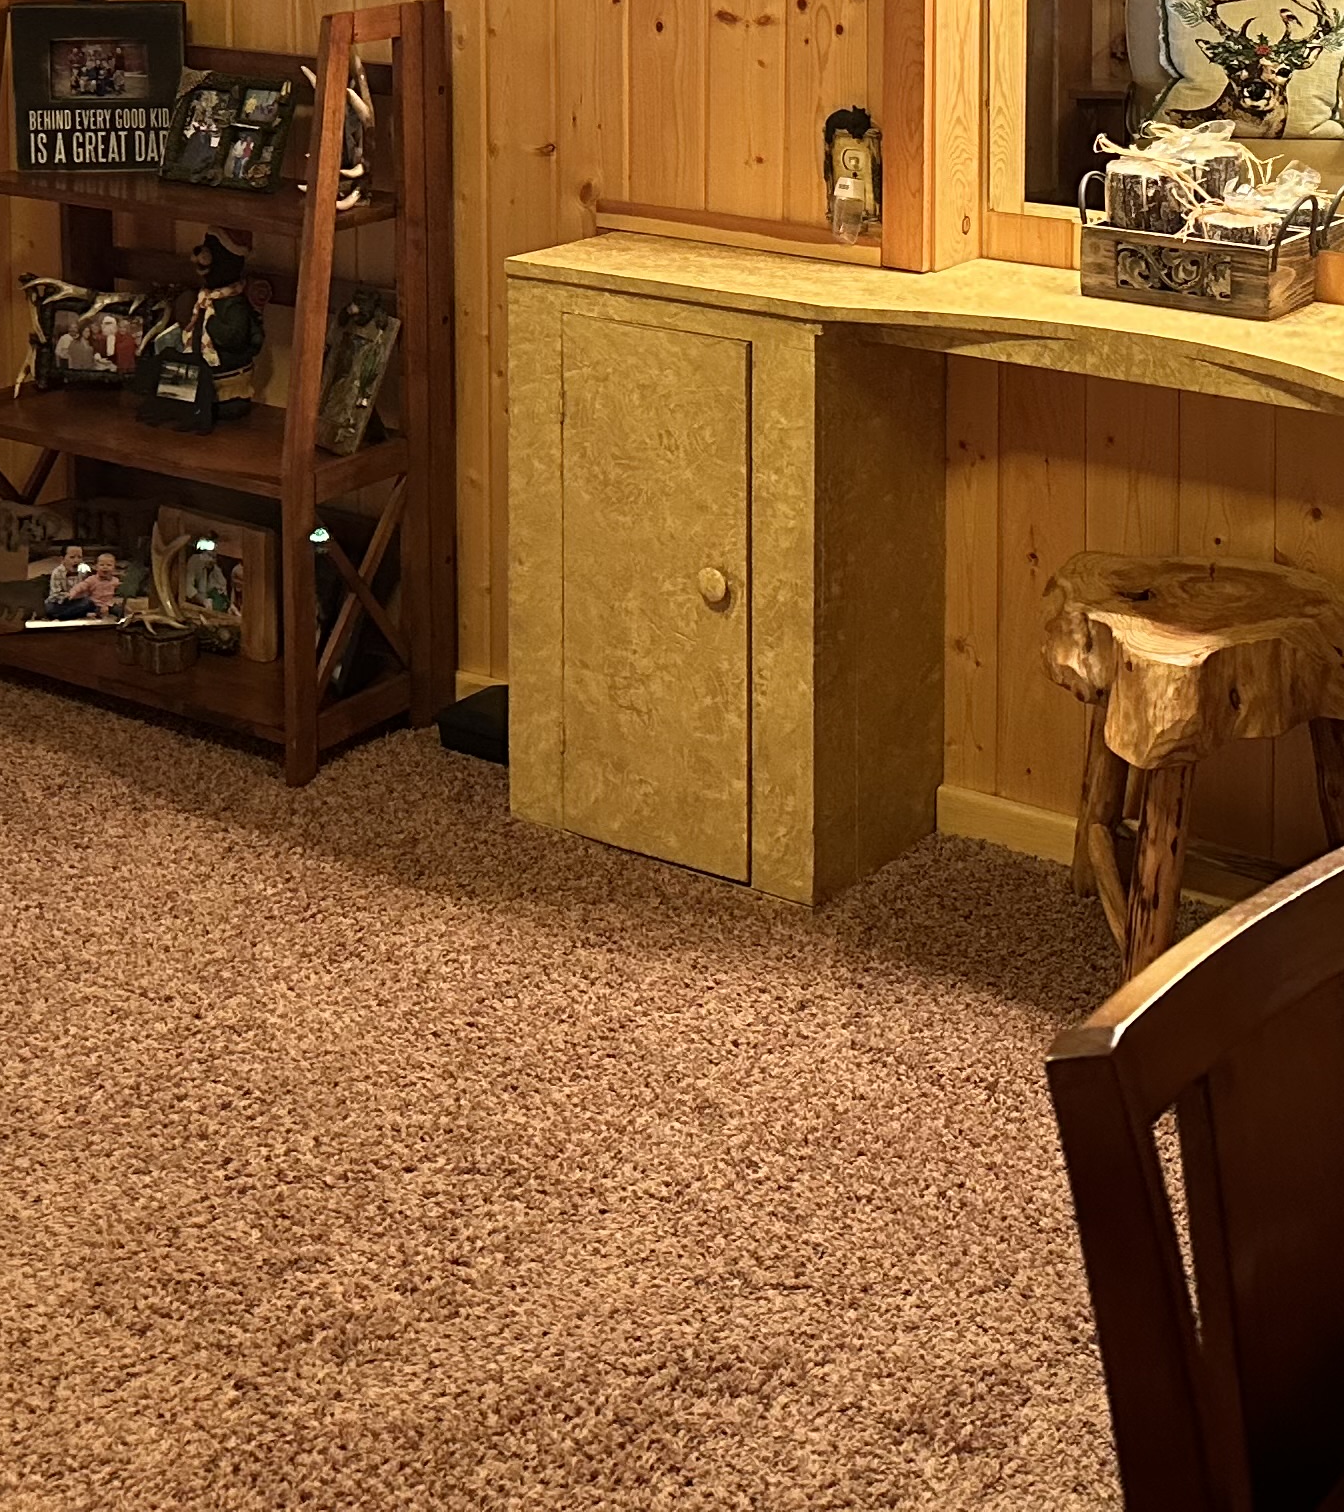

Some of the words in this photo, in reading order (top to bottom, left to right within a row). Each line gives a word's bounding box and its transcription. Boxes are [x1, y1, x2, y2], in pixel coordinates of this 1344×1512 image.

[28, 109, 72, 131] BEHIND
[75, 109, 112, 130] EVERY
[115, 108, 146, 129] GOOD
[149, 107, 170, 128] KID
[30, 132, 48, 164] IS
[54, 131, 67, 164] A
[72, 130, 128, 163] GREAT
